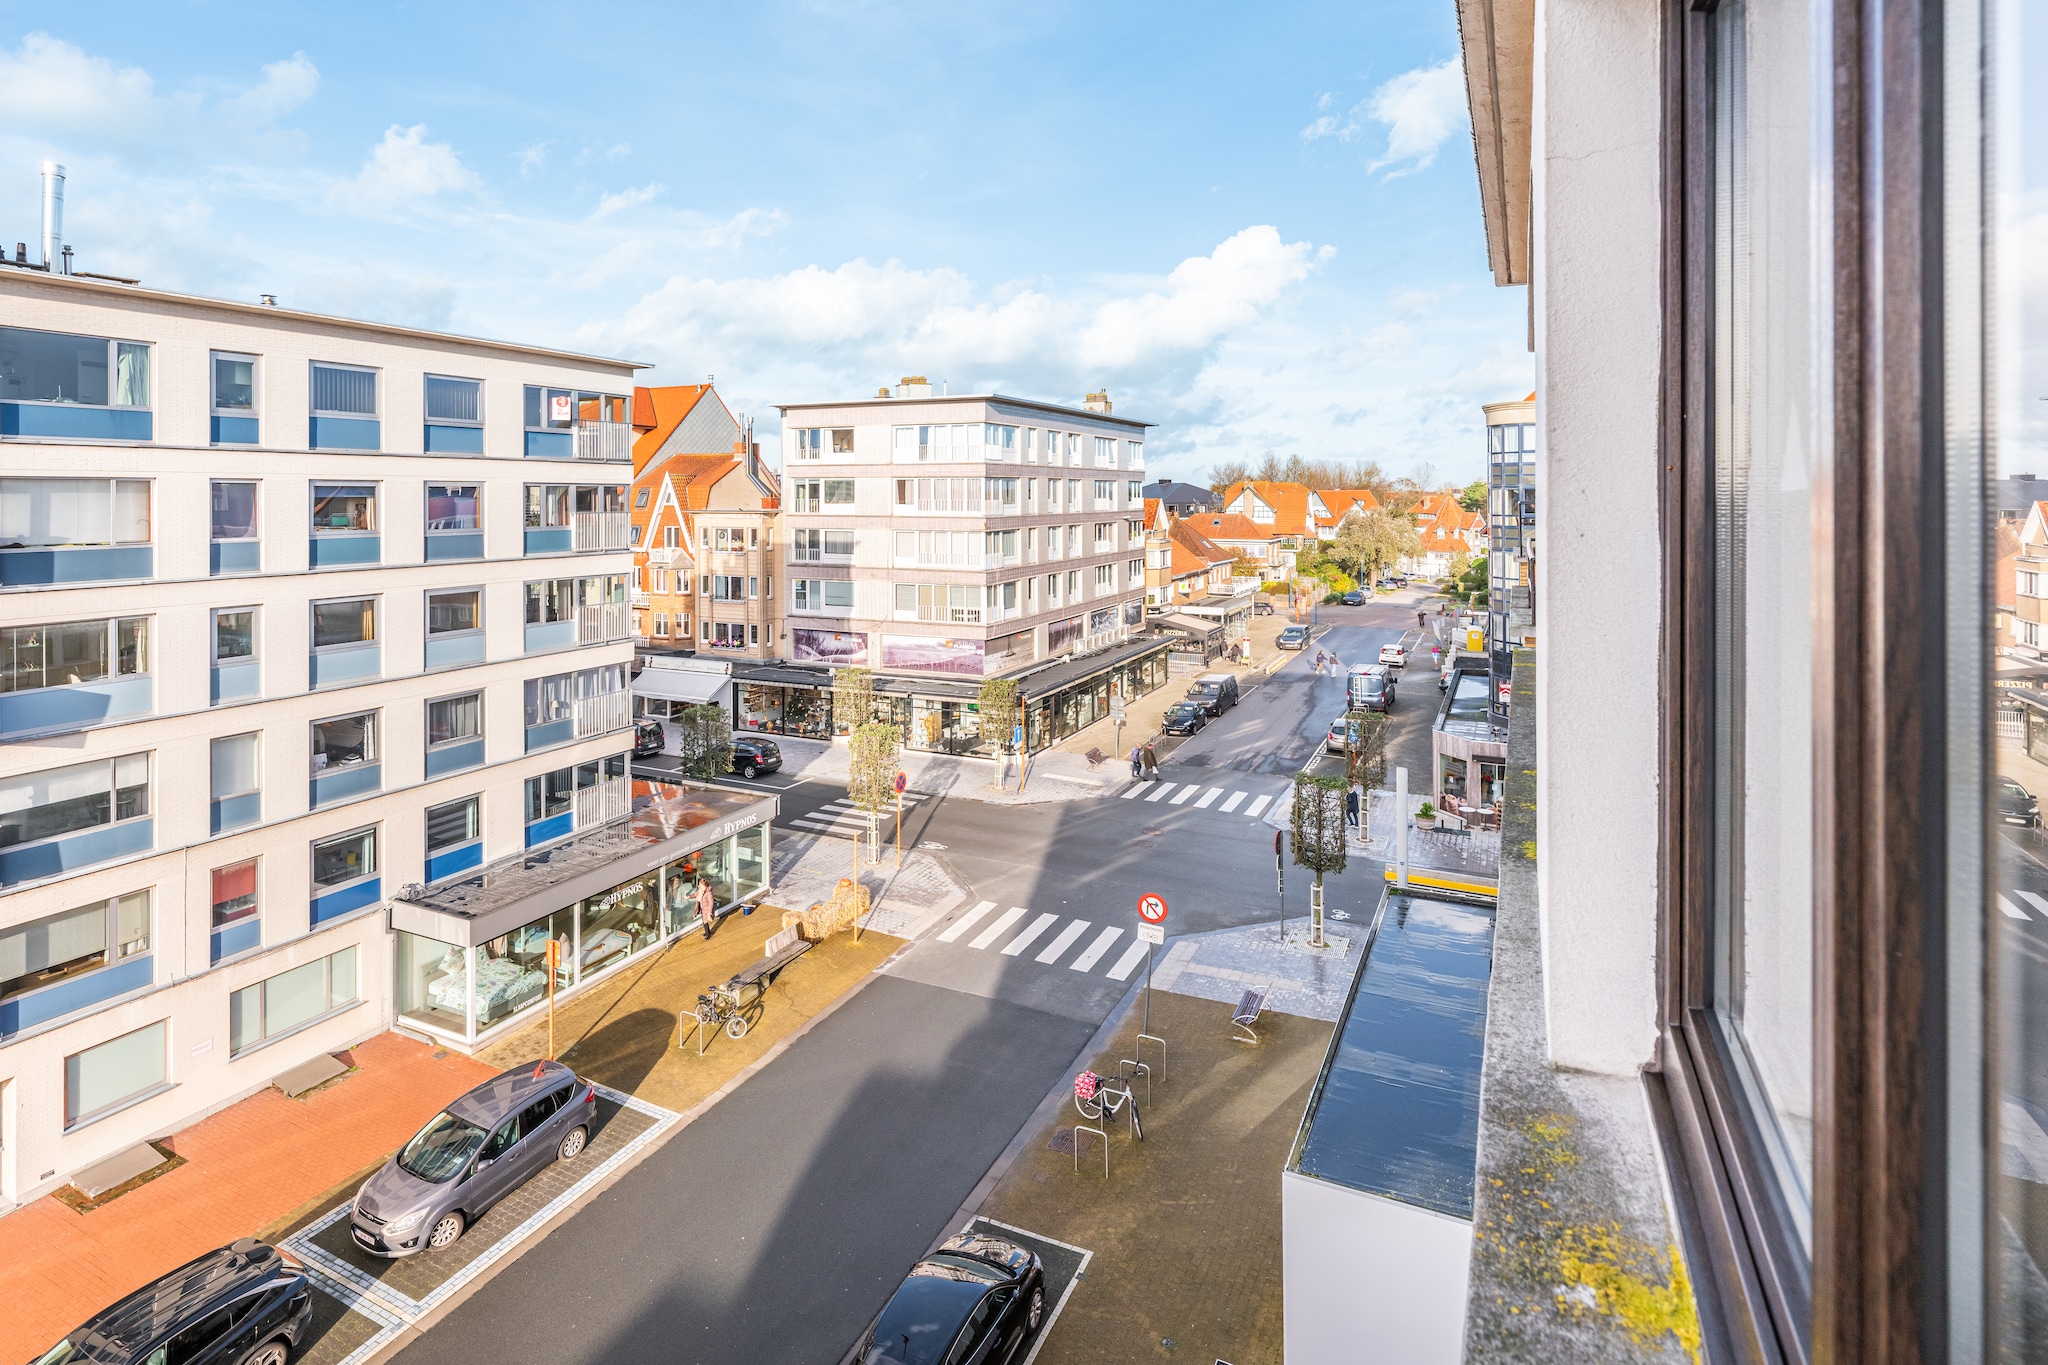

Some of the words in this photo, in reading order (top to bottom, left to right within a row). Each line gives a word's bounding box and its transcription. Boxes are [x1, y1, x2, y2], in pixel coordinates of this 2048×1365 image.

[723, 813, 757, 836] HYPNOS
[647, 859, 659, 868] voor
[660, 855, 670, 863] een
[669, 845, 690, 859] gezonde
[610, 882, 644, 904] HYPNOS
[512, 993, 543, 1013] SLAAPCOMFORT
